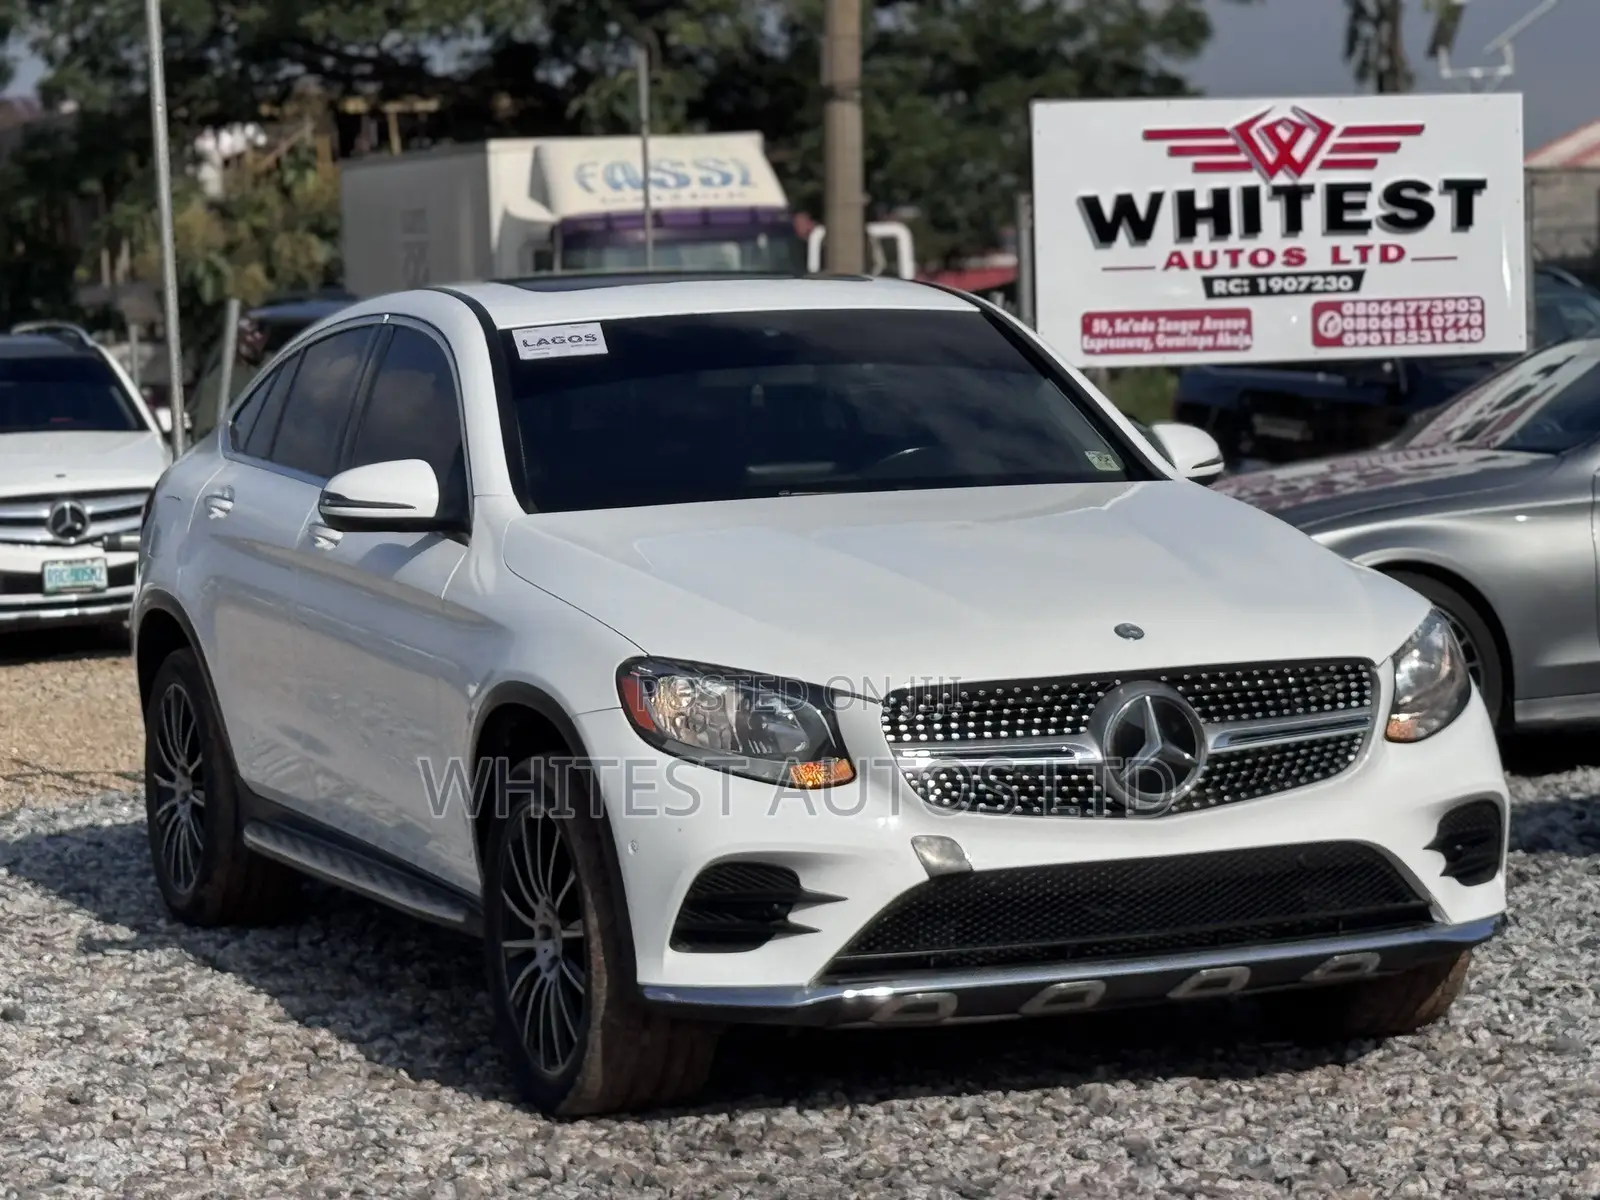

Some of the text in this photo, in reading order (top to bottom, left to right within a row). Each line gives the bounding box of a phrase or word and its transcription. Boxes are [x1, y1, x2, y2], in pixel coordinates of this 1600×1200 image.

[1076, 178, 1488, 250] WHITEST
[1162, 244, 1407, 272] AUTOS LTD
[1212, 275, 1354, 295] RC: 1907230
[1341, 298, 1483, 316] 08064773903
[522, 333, 598, 348] LAGOS
